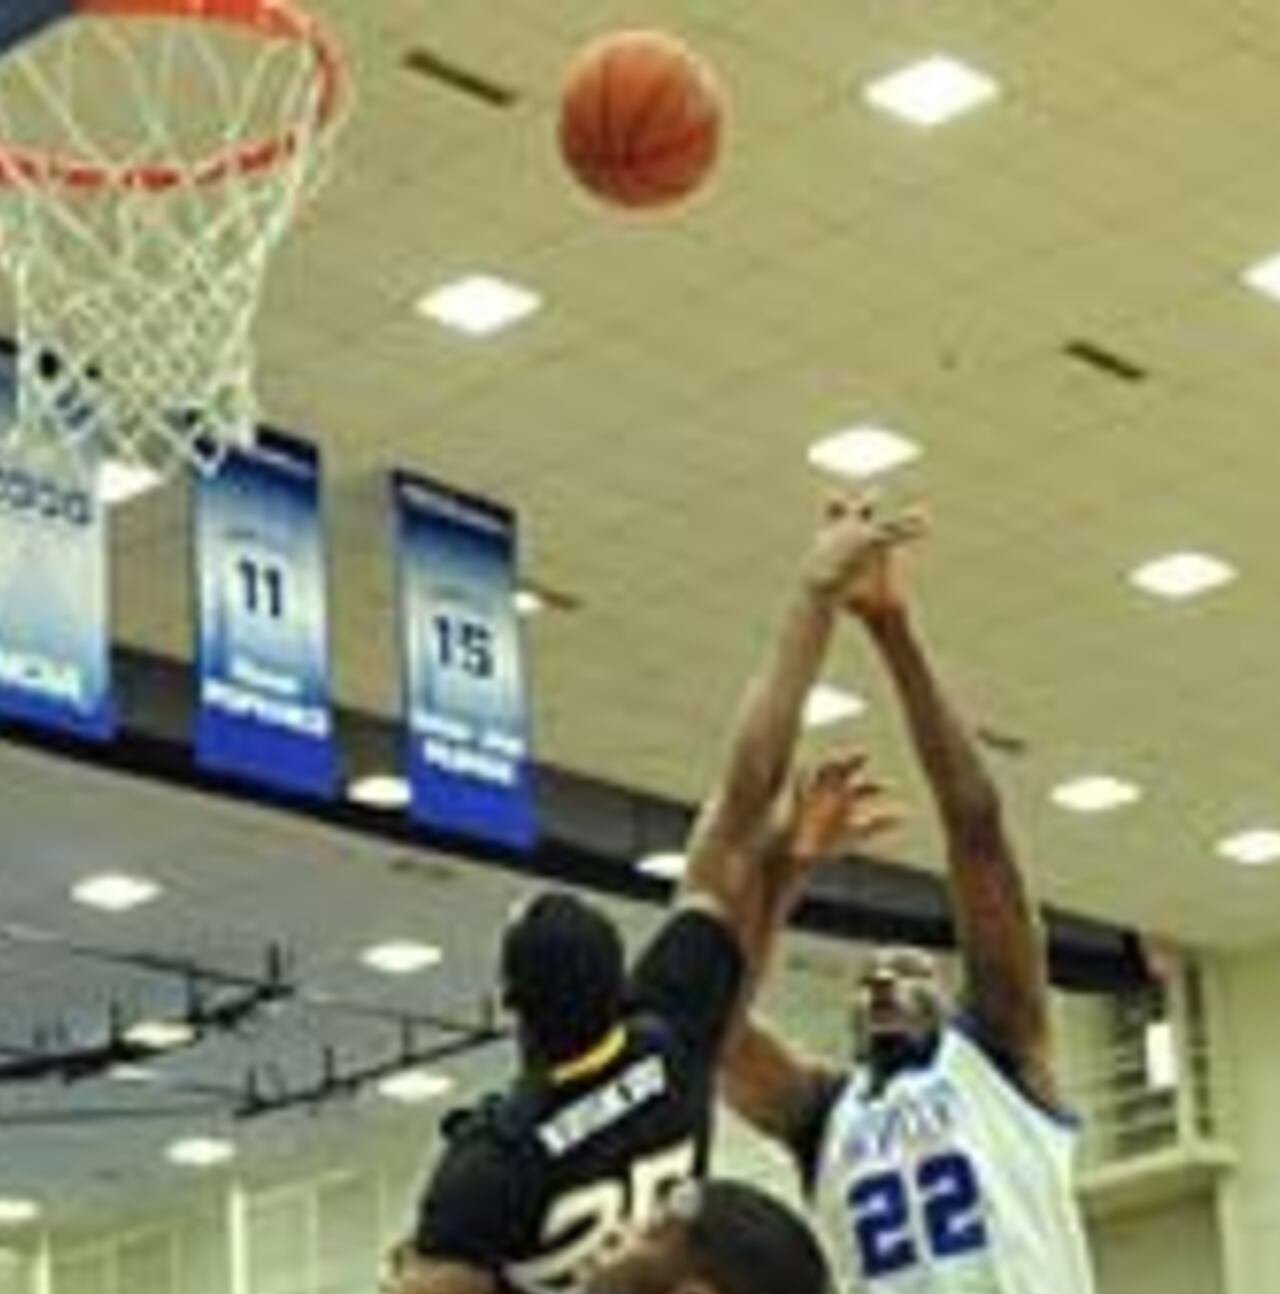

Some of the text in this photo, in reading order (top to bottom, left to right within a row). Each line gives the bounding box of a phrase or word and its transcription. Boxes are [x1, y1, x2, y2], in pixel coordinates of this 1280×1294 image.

[237, 554, 283, 619] 11
[433, 613, 494, 680] 15
[846, 1148, 990, 1284] 22
